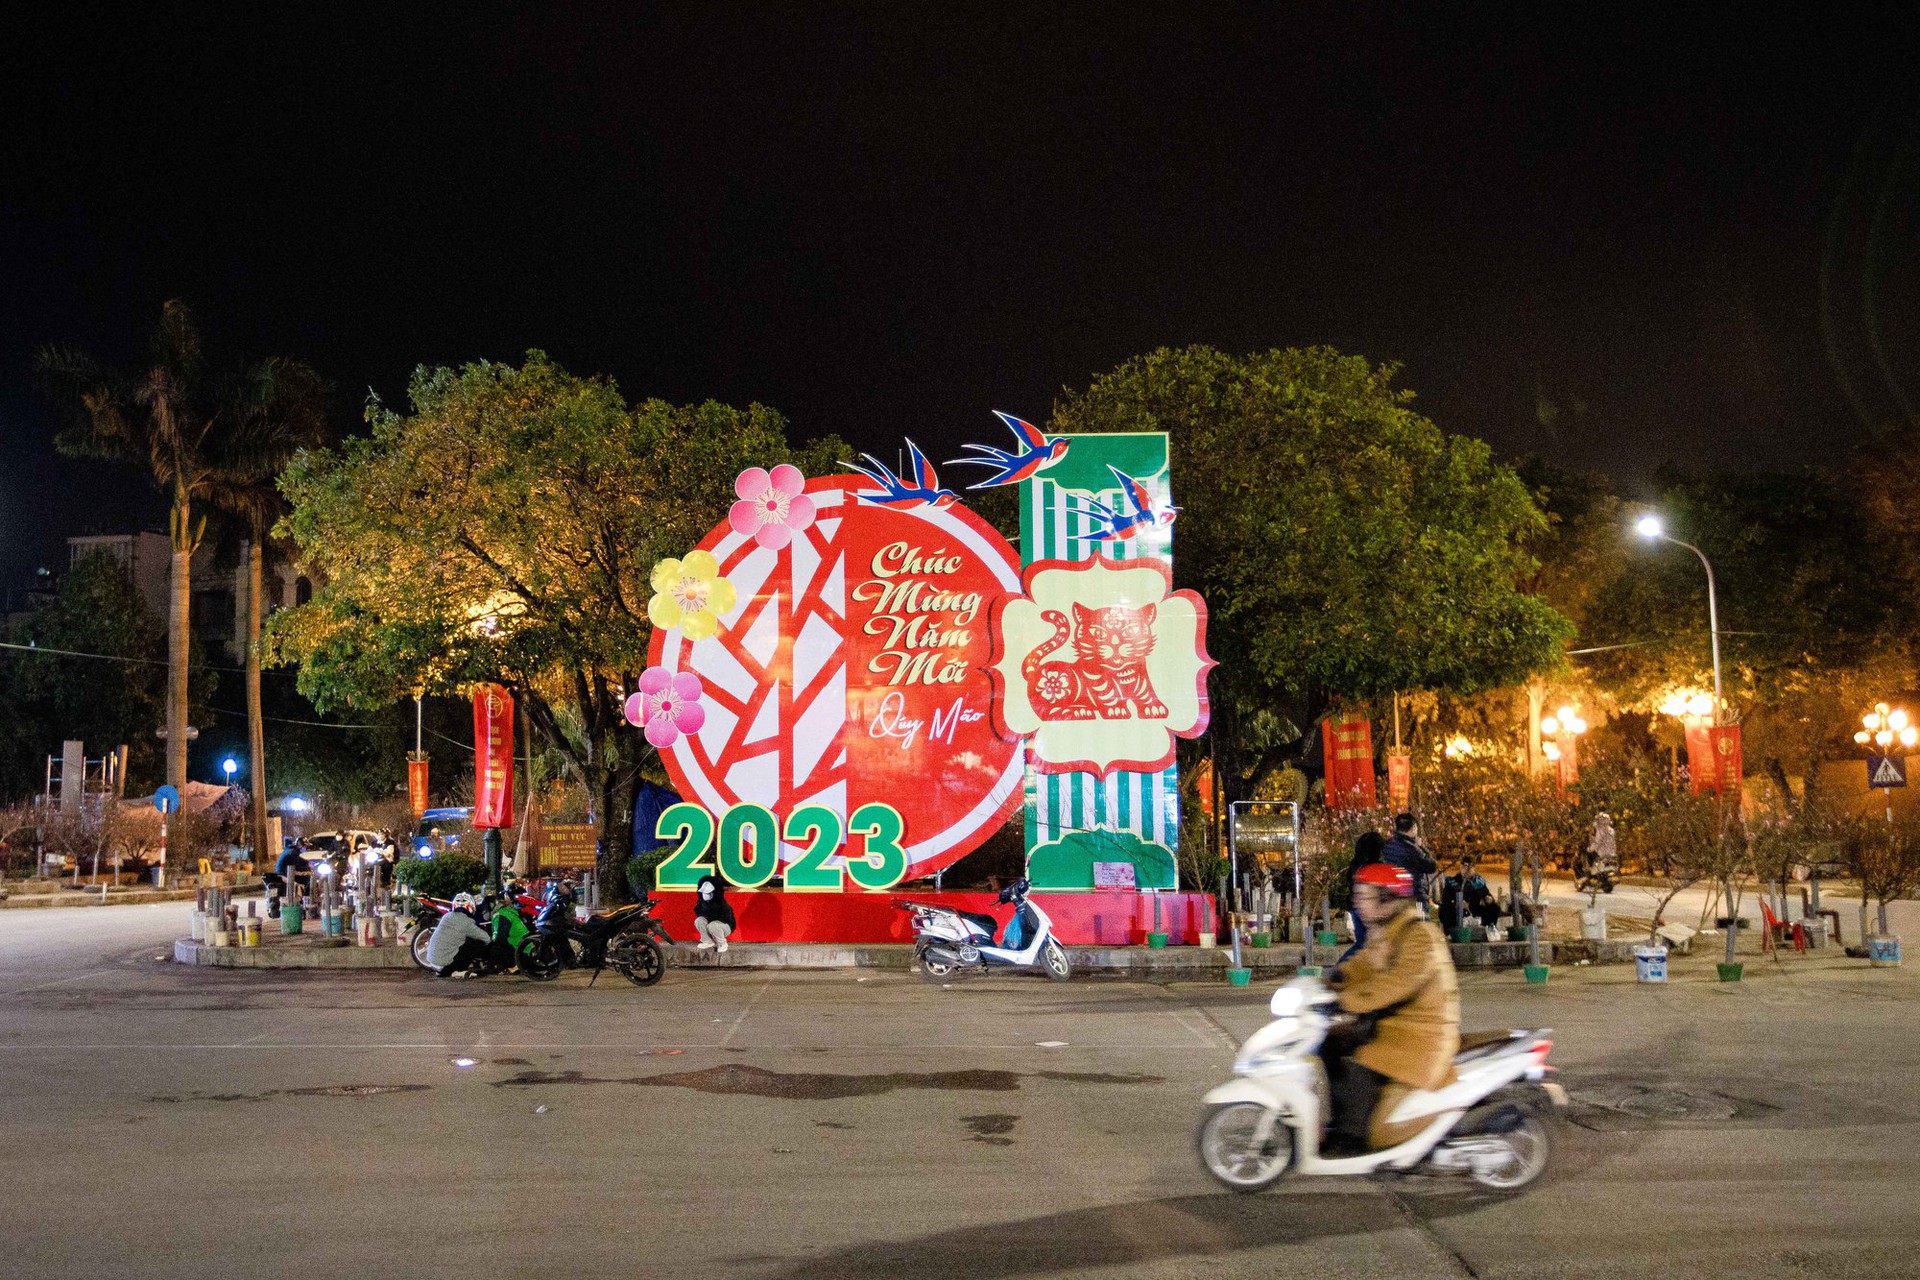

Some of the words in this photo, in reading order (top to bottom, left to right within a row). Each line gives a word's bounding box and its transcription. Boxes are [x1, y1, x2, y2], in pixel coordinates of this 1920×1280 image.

[870, 541, 962, 578] Chúc
[851, 579, 983, 626] Mừng
[863, 615, 972, 650] Năm
[868, 651, 969, 686] Mới
[929, 697, 985, 745] Mão
[655, 801, 908, 893] 2023
